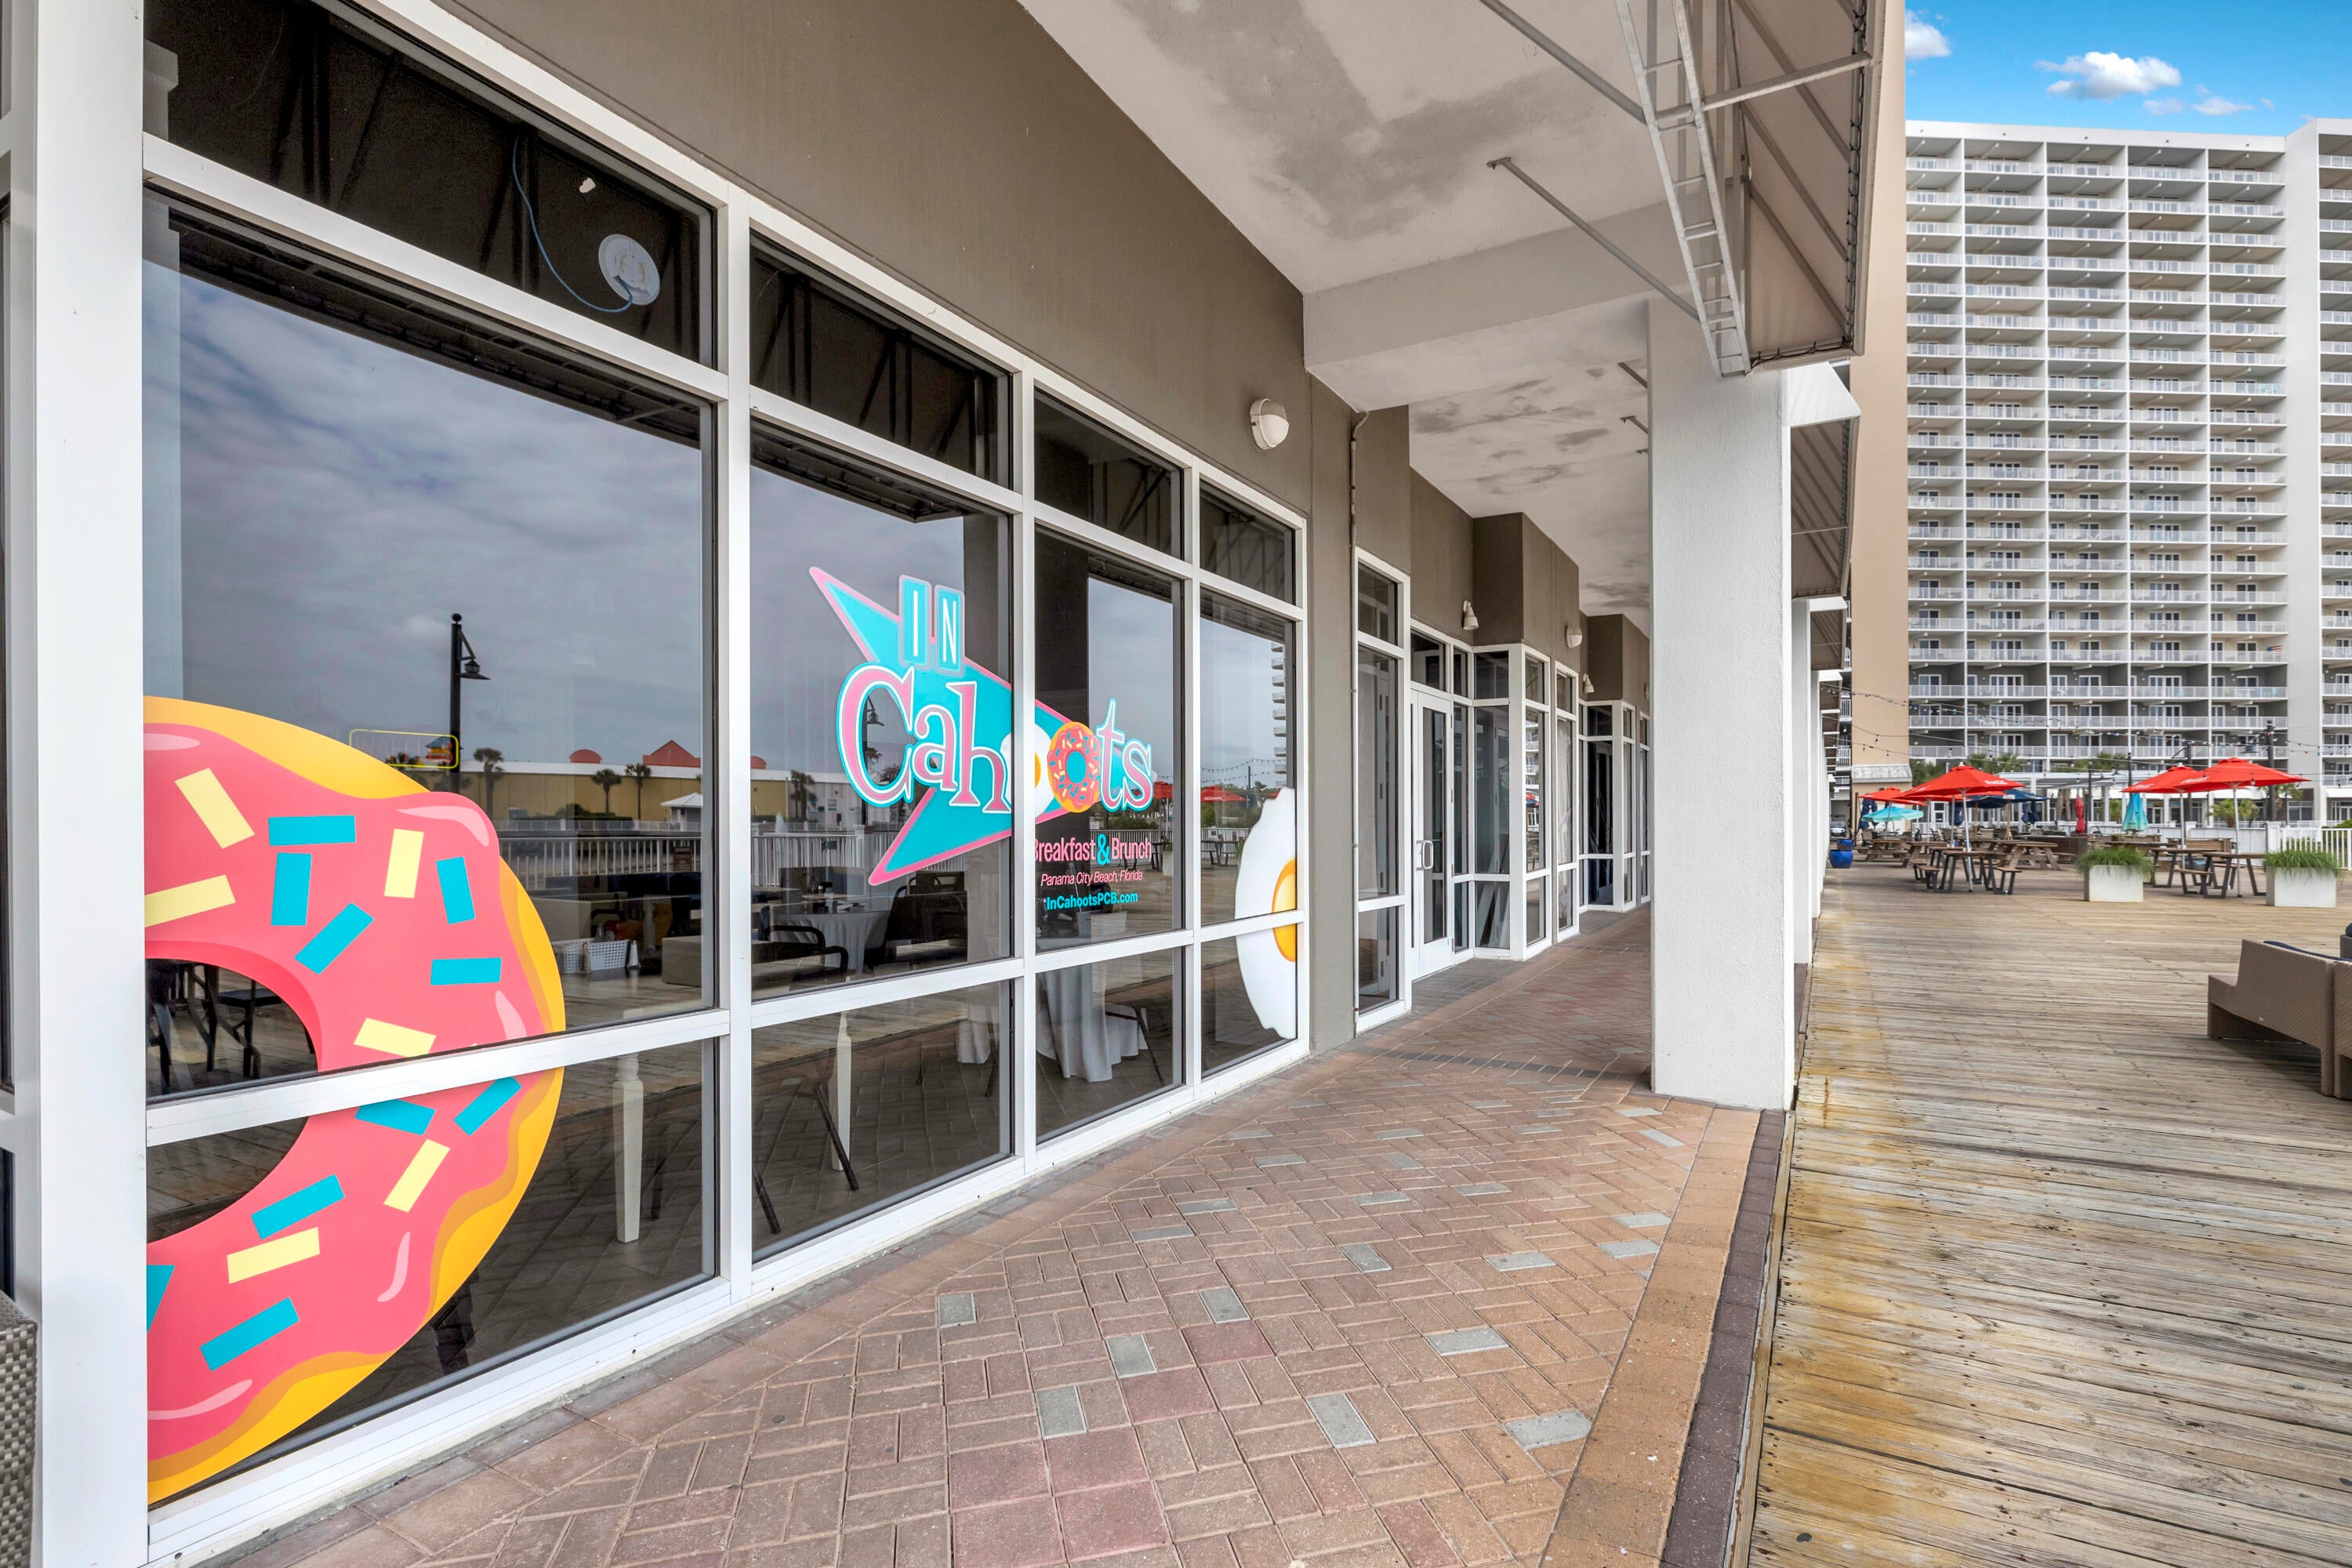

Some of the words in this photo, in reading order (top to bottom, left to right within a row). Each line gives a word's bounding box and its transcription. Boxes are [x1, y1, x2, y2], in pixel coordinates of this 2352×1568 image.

[903, 580, 962, 671] IN
[1098, 833, 1110, 866] &
[1112, 837, 1152, 860] Brunch
[1041, 873, 1074, 887] Panama
[1076, 872, 1093, 887] City
[1094, 870, 1119, 884] Beach,
[1120, 868, 1143, 882] Florida
[1046, 891, 1138, 910] InCahootsPCB.com
